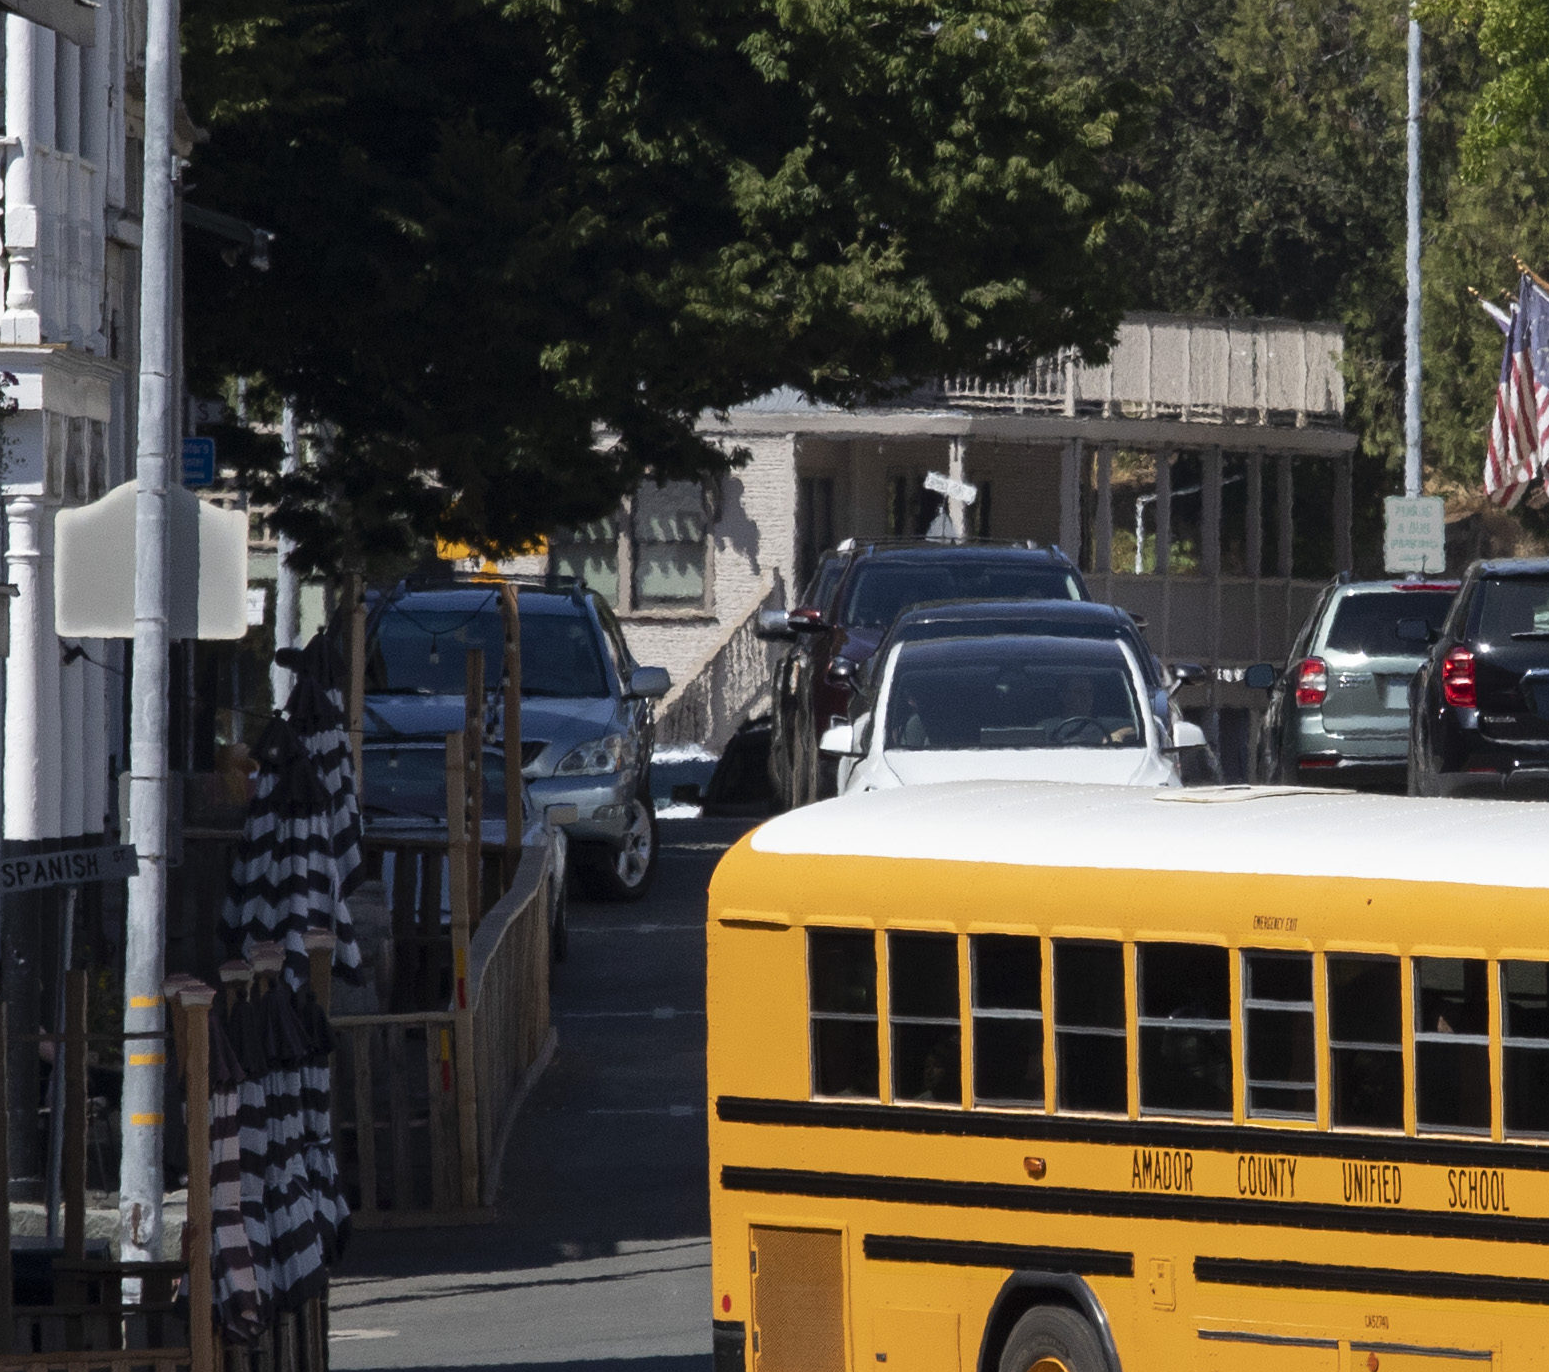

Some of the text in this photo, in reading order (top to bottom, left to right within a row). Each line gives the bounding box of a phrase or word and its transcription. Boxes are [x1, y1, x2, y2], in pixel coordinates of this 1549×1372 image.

[1, 854, 100, 888] SPANISH
[1132, 1149, 1193, 1191] AMADOR
[1237, 1155, 1298, 1198] COUNTY
[1342, 1162, 1402, 1205] UNIFIED
[1447, 1169, 1510, 1212] SCHOOL
